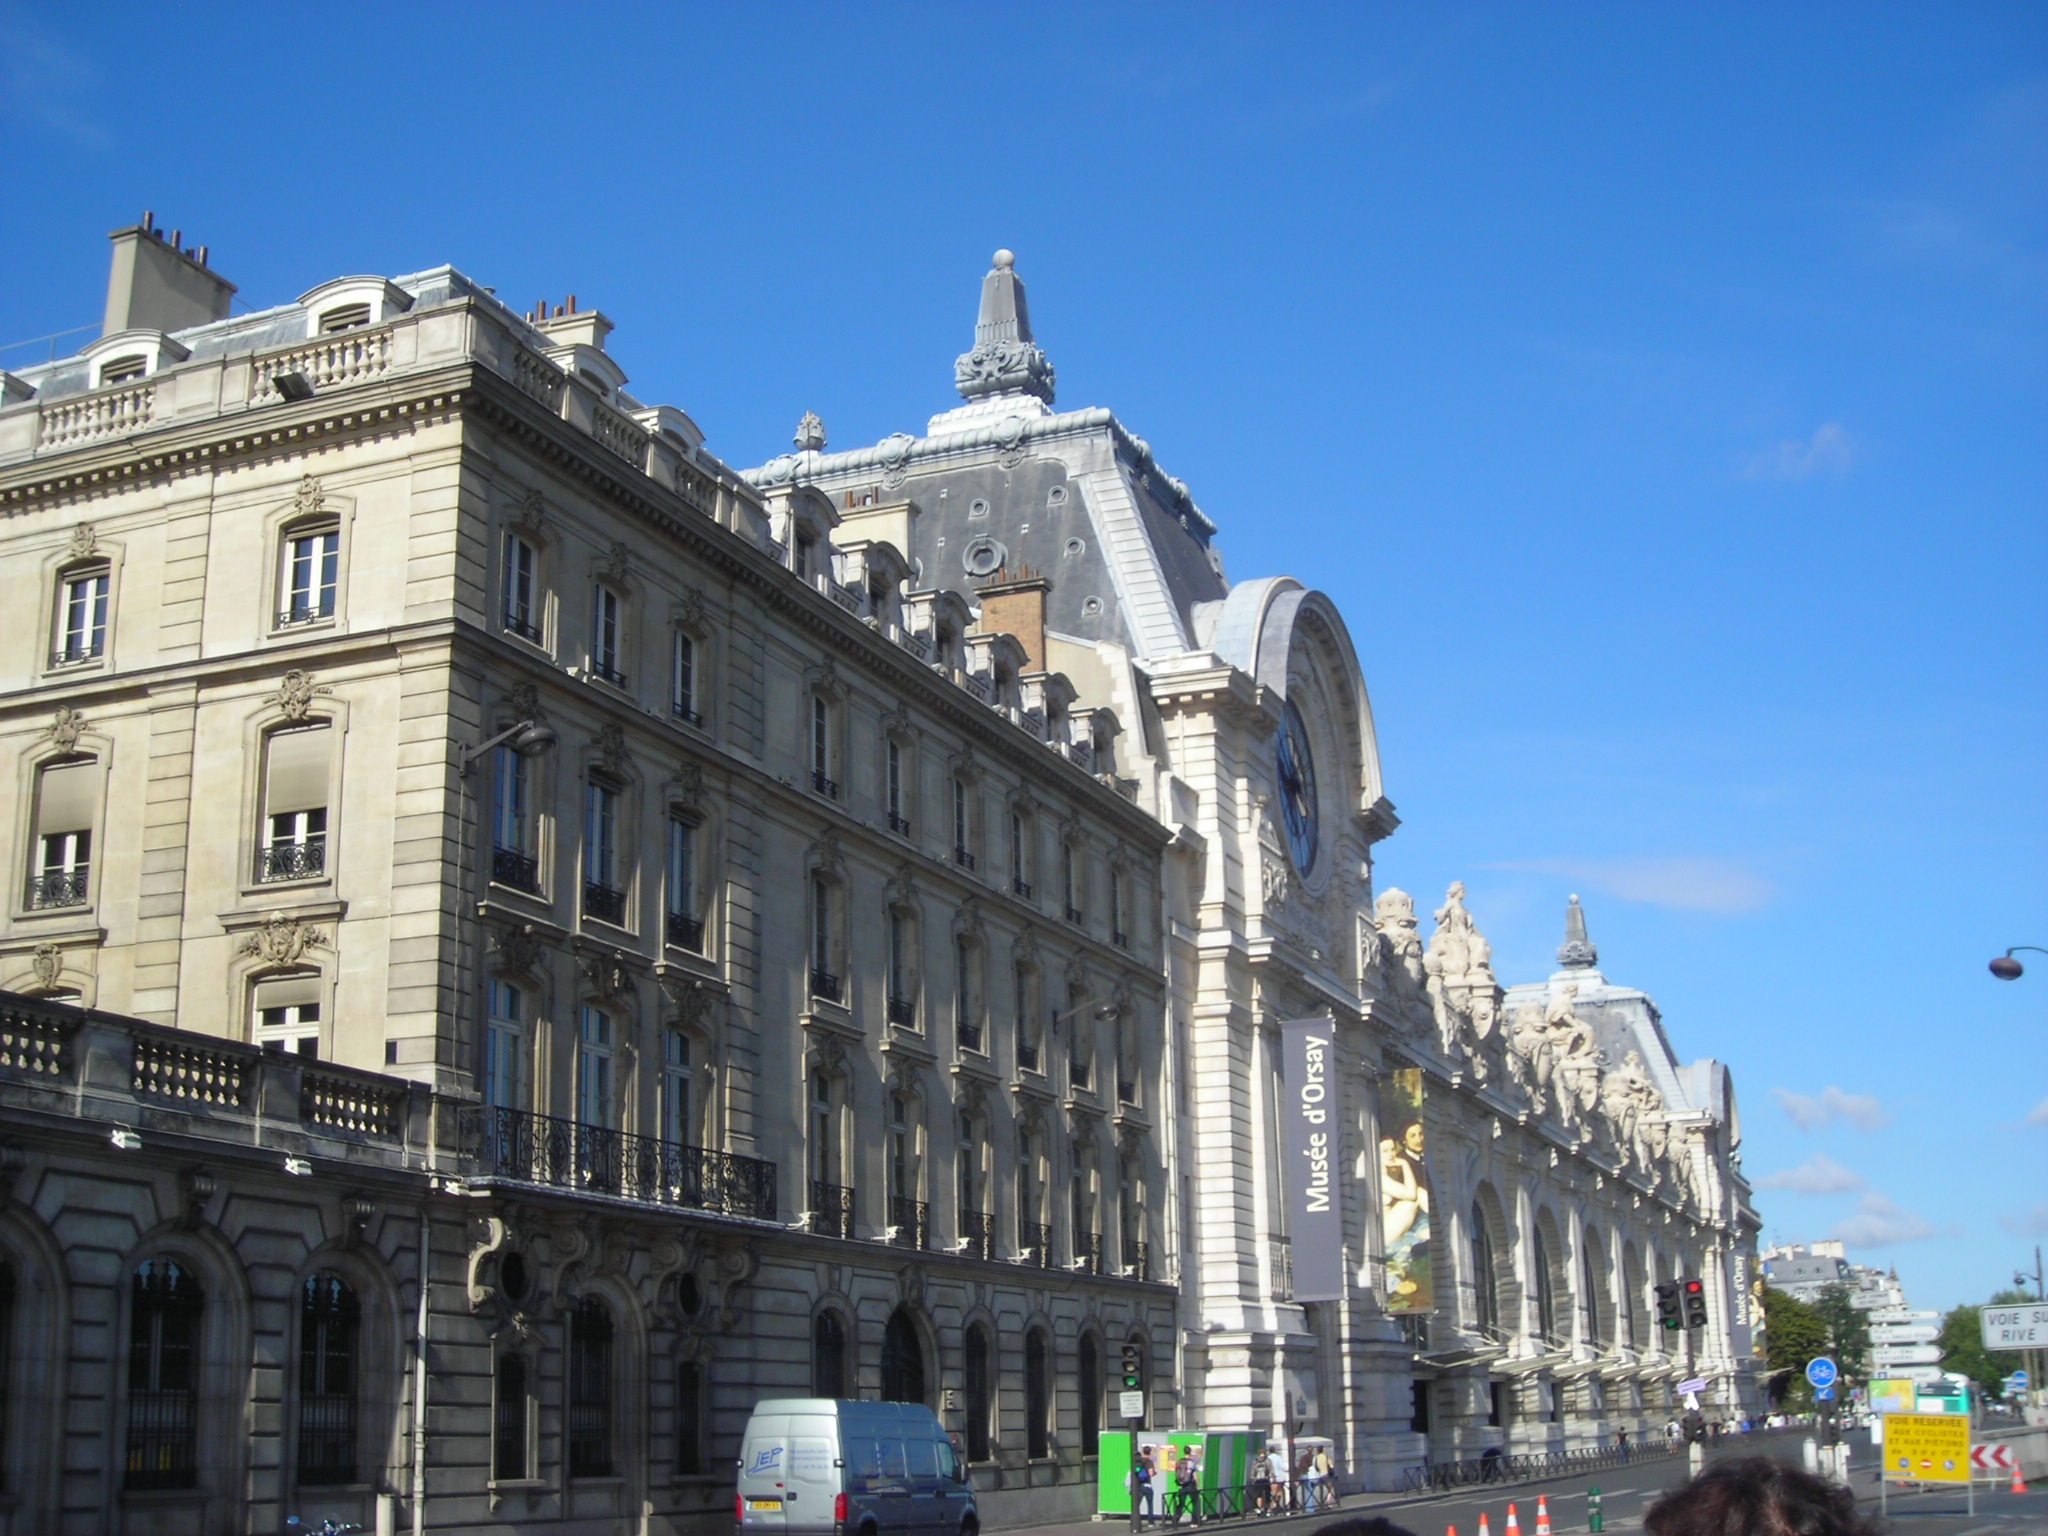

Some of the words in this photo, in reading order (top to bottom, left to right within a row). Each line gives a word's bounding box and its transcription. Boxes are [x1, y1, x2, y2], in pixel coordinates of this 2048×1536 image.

[1301, 1035, 1329, 1124] d'Orsay
[1303, 1133, 1330, 1213] Musée
[1734, 1293, 1747, 1325] Musée
[1988, 1312, 2020, 1326] VOIE
[2001, 1328, 2036, 1341] RIVE
